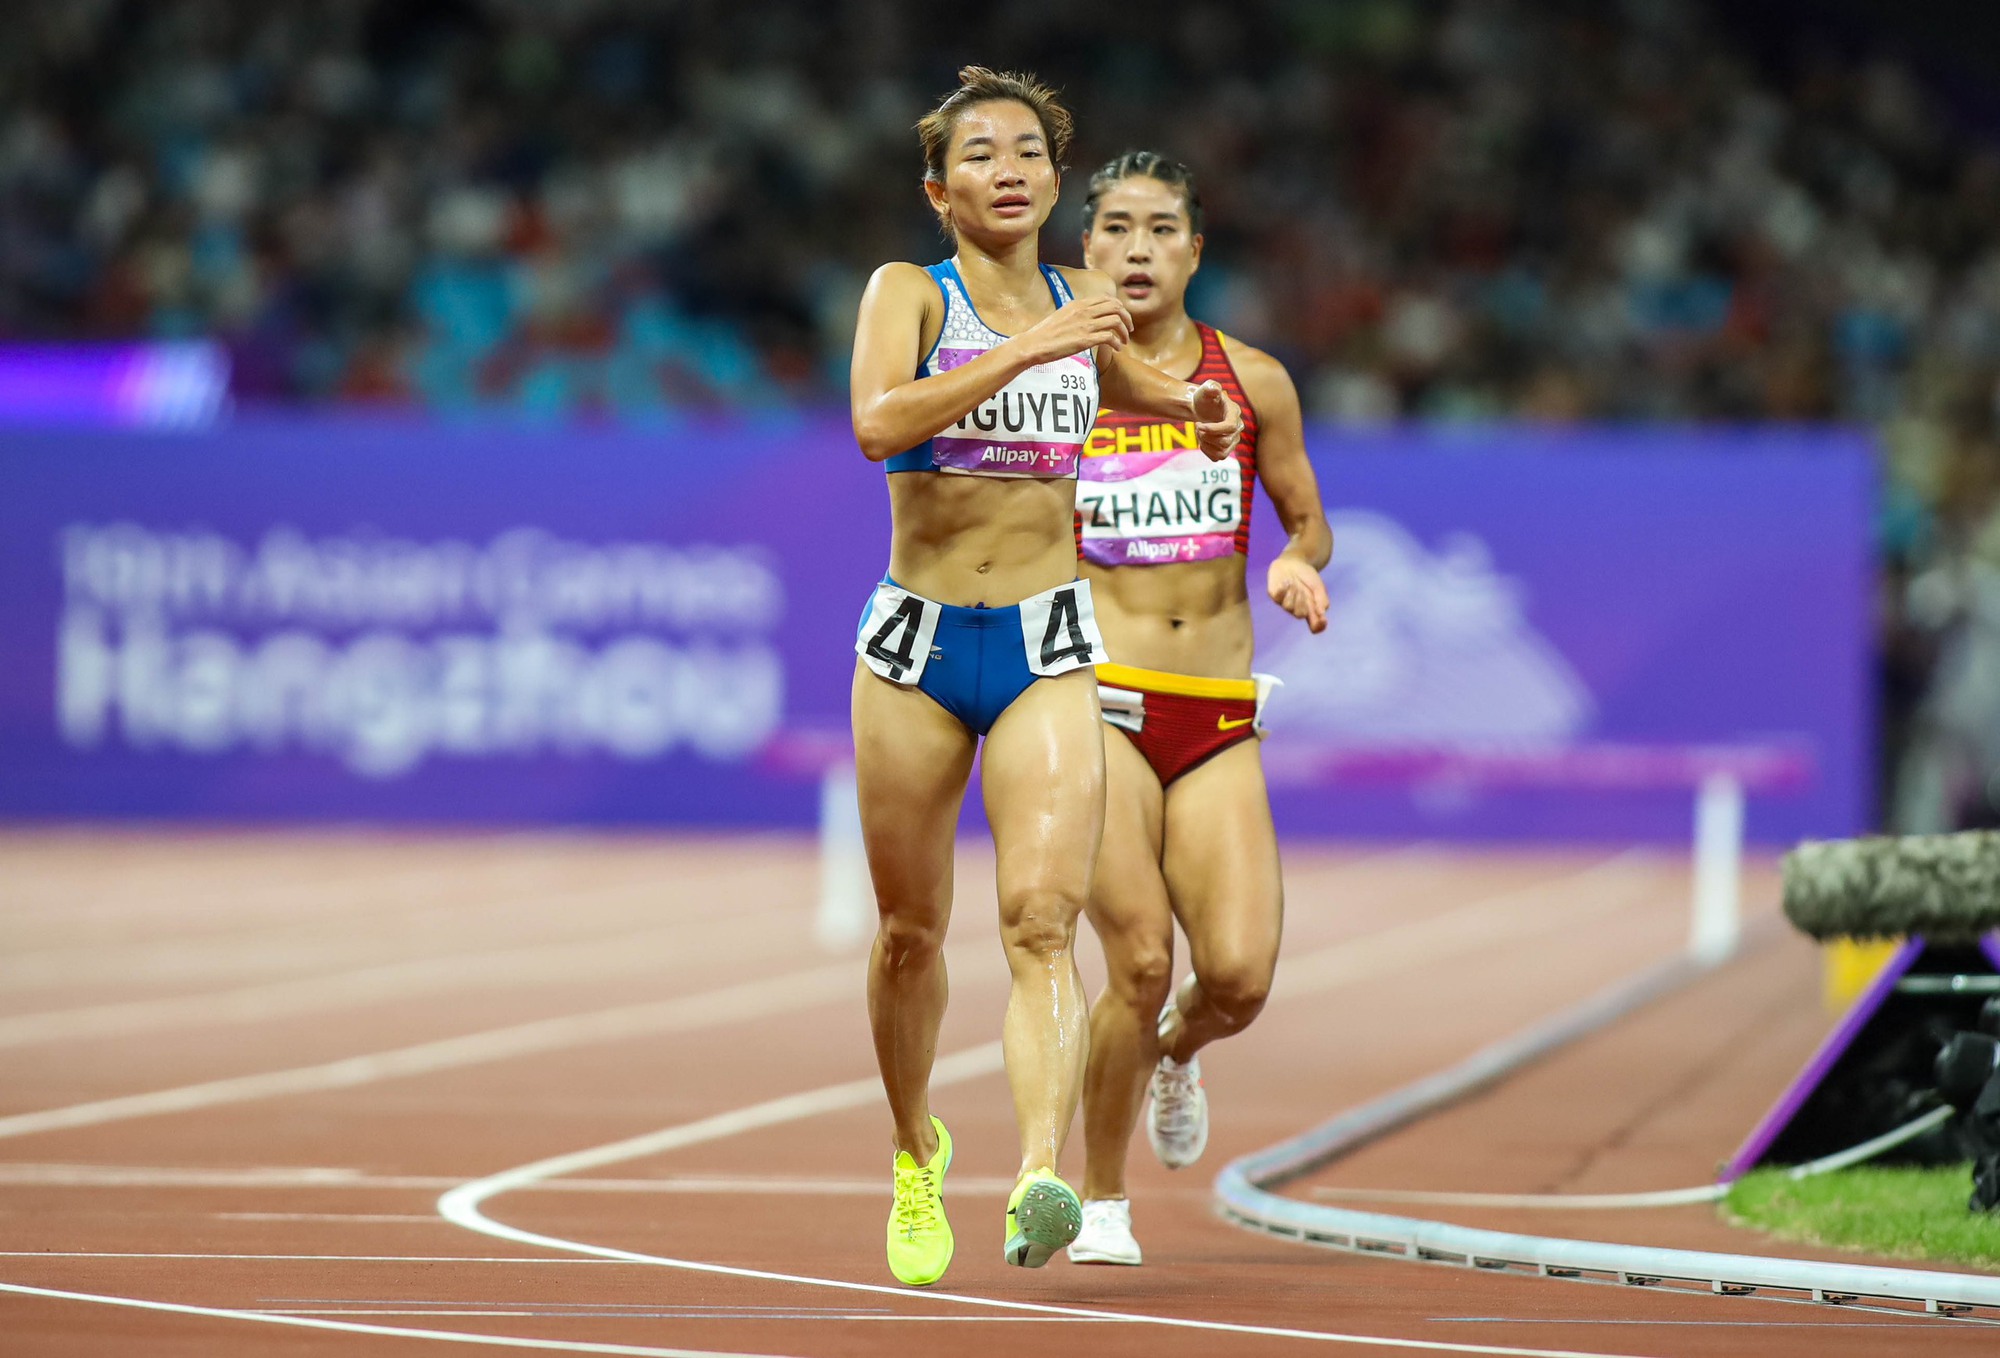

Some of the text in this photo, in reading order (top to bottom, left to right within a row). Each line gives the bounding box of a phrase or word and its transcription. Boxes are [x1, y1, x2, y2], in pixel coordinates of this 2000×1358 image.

[1061, 374, 1086, 391] 938
[1083, 421, 1198, 457] CHIN
[981, 446, 1040, 465] Alipay
[1202, 469, 1229, 484] 190
[1083, 488, 1233, 529] ZHANG
[1126, 541, 1180, 559] Alipay
[866, 595, 925, 681] 4
[1040, 588, 1093, 667] 4
